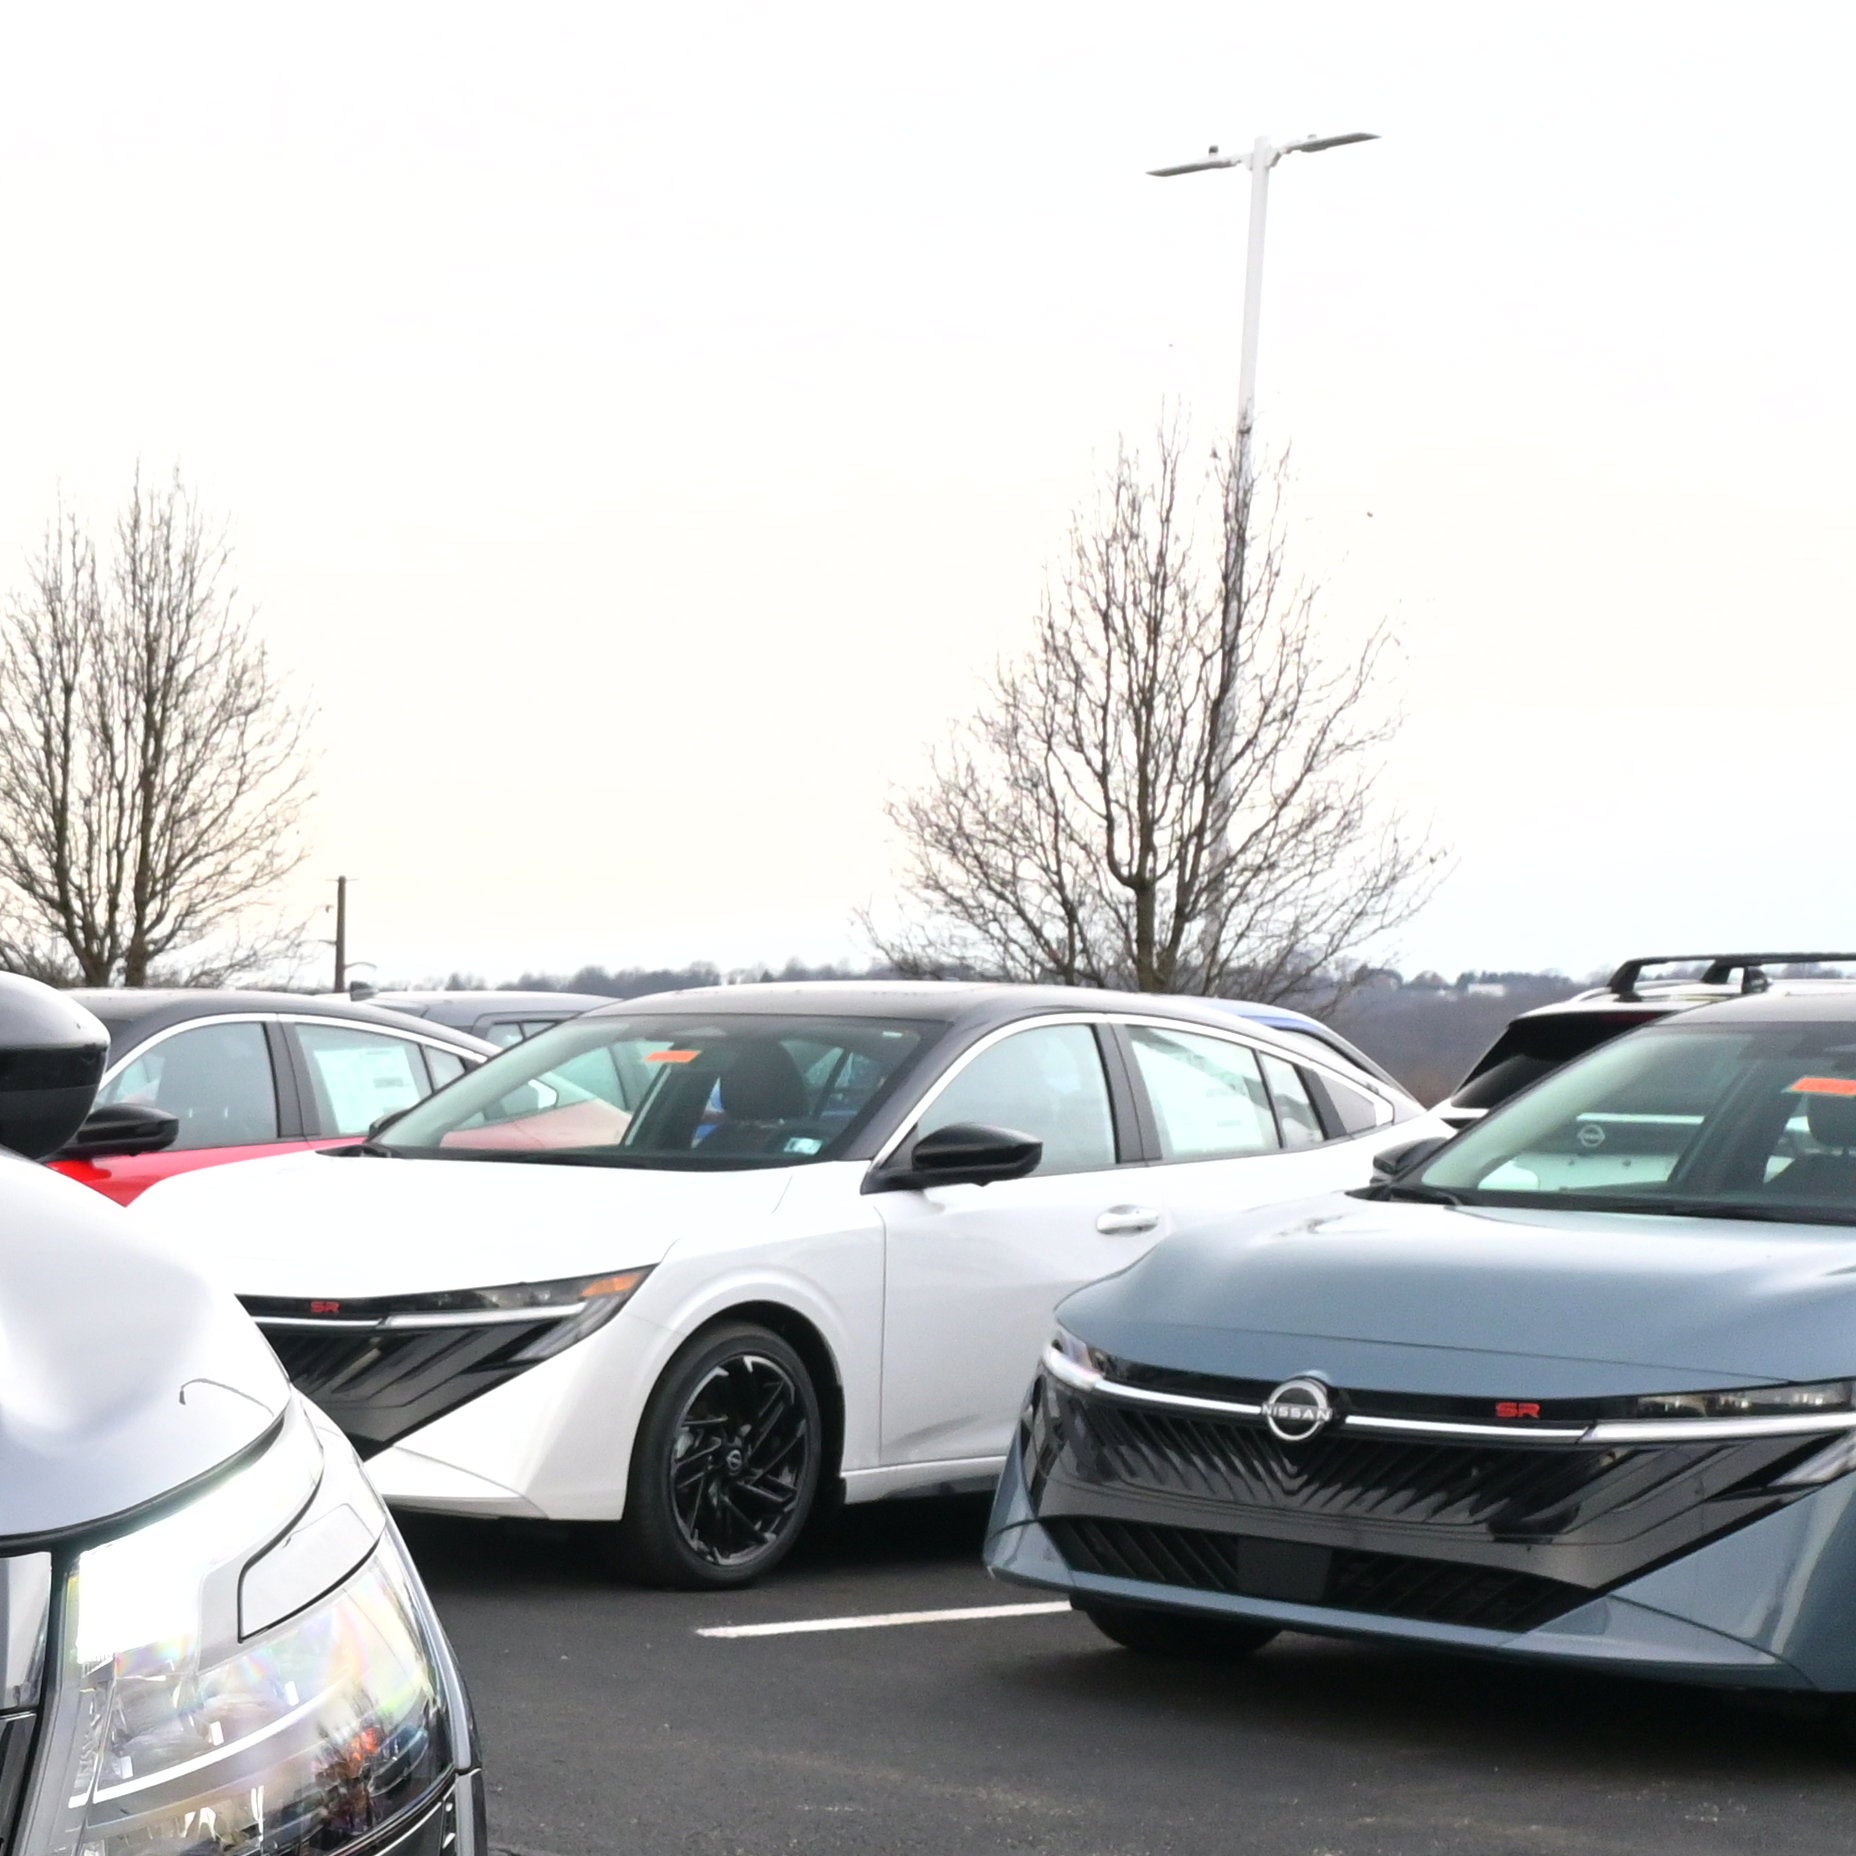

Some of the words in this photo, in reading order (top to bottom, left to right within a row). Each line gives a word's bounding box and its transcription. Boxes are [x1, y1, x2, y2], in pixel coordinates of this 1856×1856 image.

[310, 1301, 341, 1314] SR
[1262, 1402, 1332, 1422] NISSAN
[1496, 1402, 1540, 1418] SR
